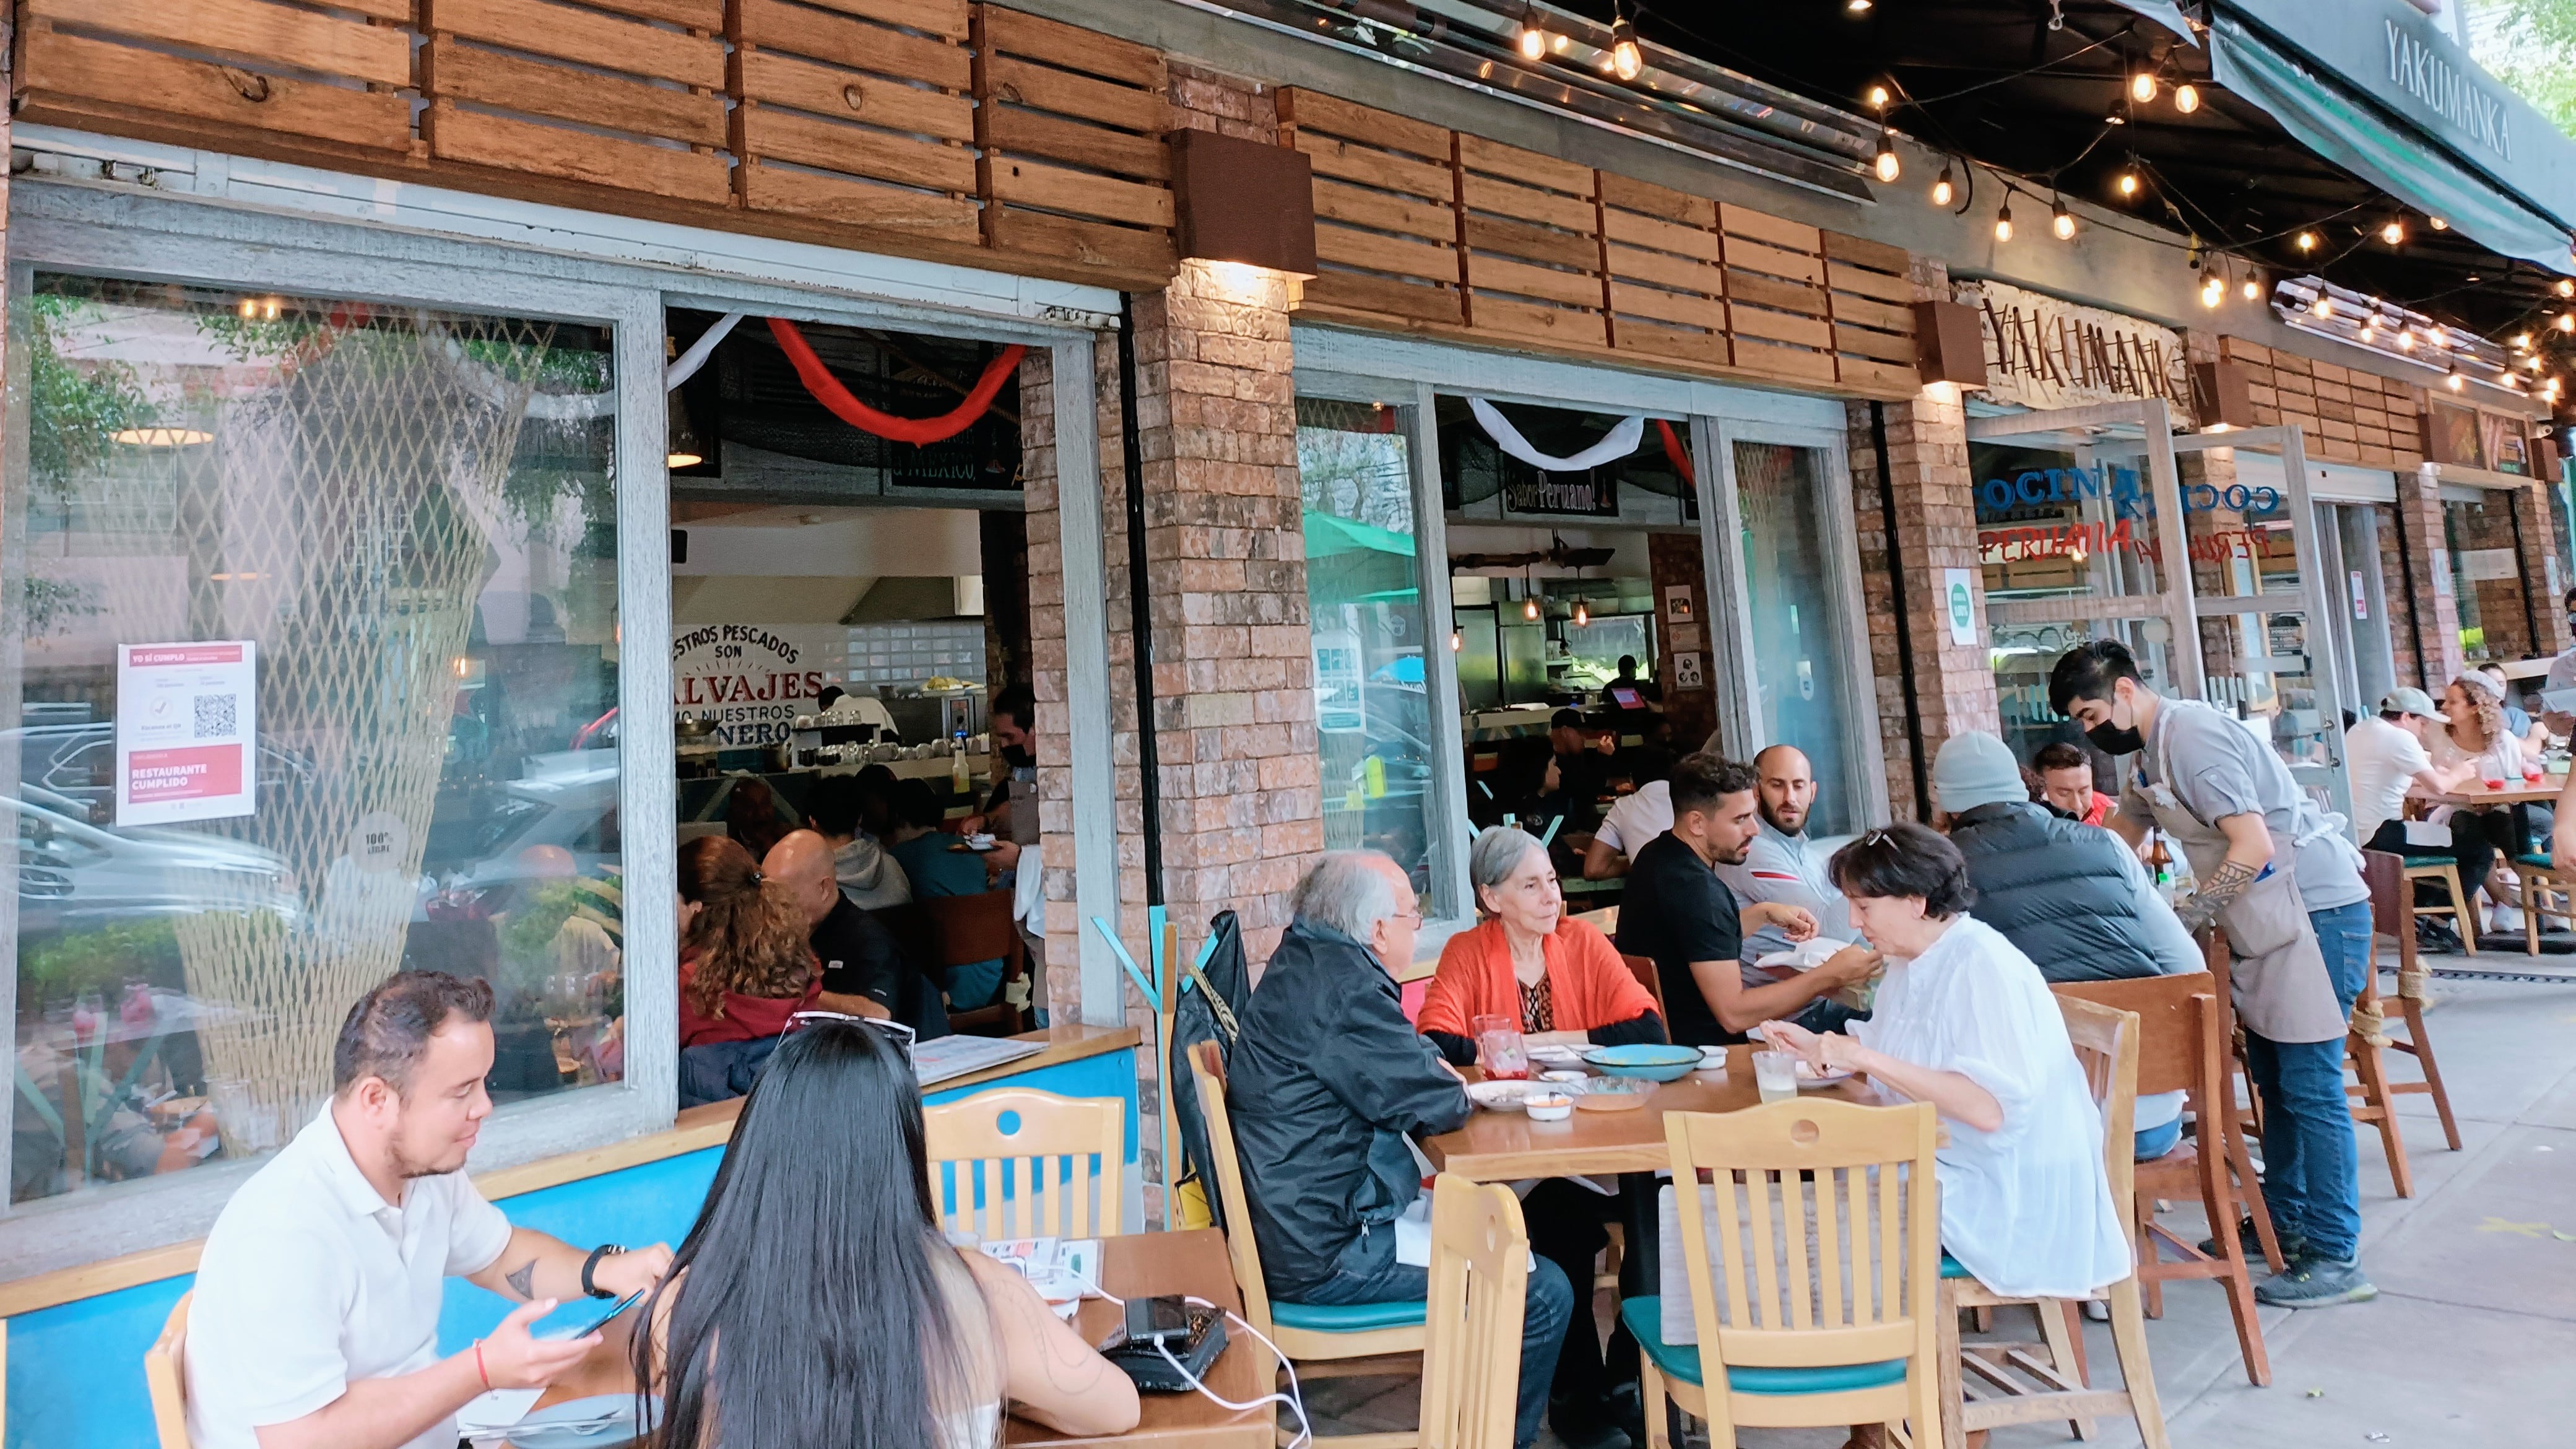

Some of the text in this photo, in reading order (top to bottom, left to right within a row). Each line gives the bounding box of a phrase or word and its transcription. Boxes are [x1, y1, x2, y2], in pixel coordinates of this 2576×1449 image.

[2385, 19, 2511, 161] YAKUMANKA
[1981, 298, 2209, 407] YAKUMANKA
[1973, 468, 2143, 515] OCINA
[715, 645, 742, 658] SON
[722, 624, 799, 664] PESCADOS
[132, 654, 143, 663] YO
[154, 653, 185, 663] CUMPLO
[702, 704, 795, 723] NUESTROS
[132, 764, 207, 779] RESTAURANTE
[131, 777, 188, 790] CUMPLIDO
